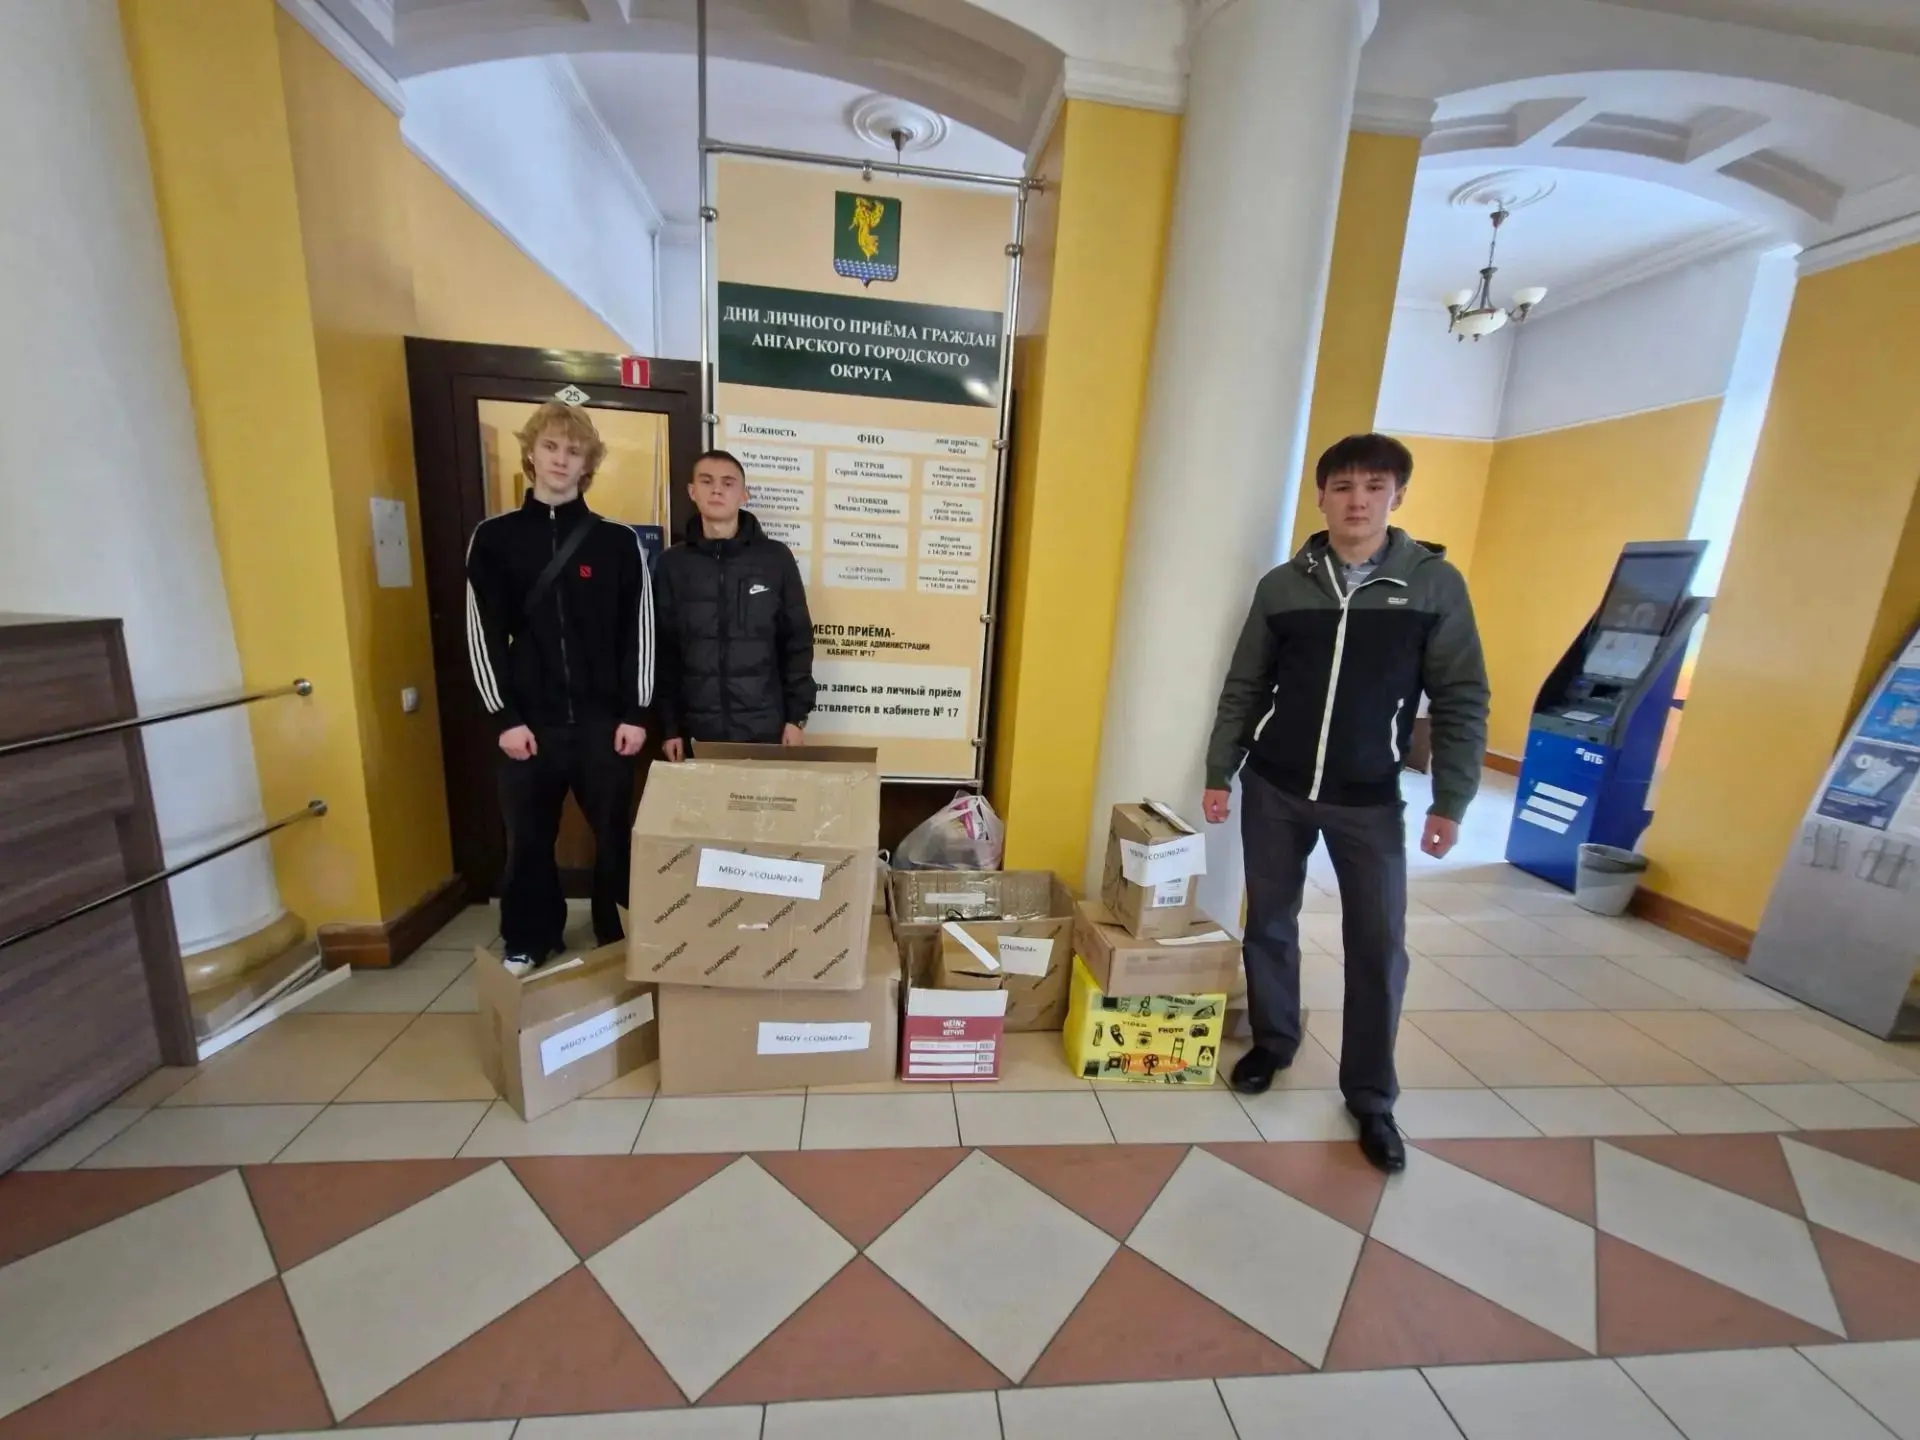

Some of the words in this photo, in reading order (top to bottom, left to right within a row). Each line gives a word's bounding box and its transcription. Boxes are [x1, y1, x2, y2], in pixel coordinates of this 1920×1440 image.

[723, 305, 760, 323] ДНИ
[763, 309, 846, 333] ЛИЧНОГО
[849, 319, 918, 341] ПРИЁМА
[922, 327, 997, 348] ГРАЖДАН
[752, 333, 861, 356] АНГАРСКОГО
[864, 344, 970, 367] ГОРОДСКОГО
[830, 363, 893, 382] ОКРУГА
[565, 389, 580, 402] 25
[739, 423, 797, 437] Должность
[857, 432, 885, 446] ФИО
[742, 451, 757, 461] Мэр
[759, 453, 799, 462] Ангарского
[742, 461, 776, 469] ородского
[854, 461, 885, 470] ПЕТРОВ
[847, 496, 888, 505] ГОЛОВКОВ
[812, 624, 845, 636] МЕСТО
[812, 638, 839, 646] ЕНИНА,
[841, 639, 868, 648] ЗДАНИЕ
[870, 641, 931, 651] АДМИНИСТРАЦИИ
[826, 648, 858, 656] КАБИНЕТ
[831, 683, 868, 693] запись
[871, 685, 884, 694] на
[886, 685, 926, 697] личный
[928, 686, 962, 700] приём
[811, 703, 871, 714] ествляется
[883, 704, 931, 716] кабинете
[947, 707, 959, 718] 17
[1583, 751, 1603, 765] ВТБ
[718, 864, 747, 877] МБОУ
